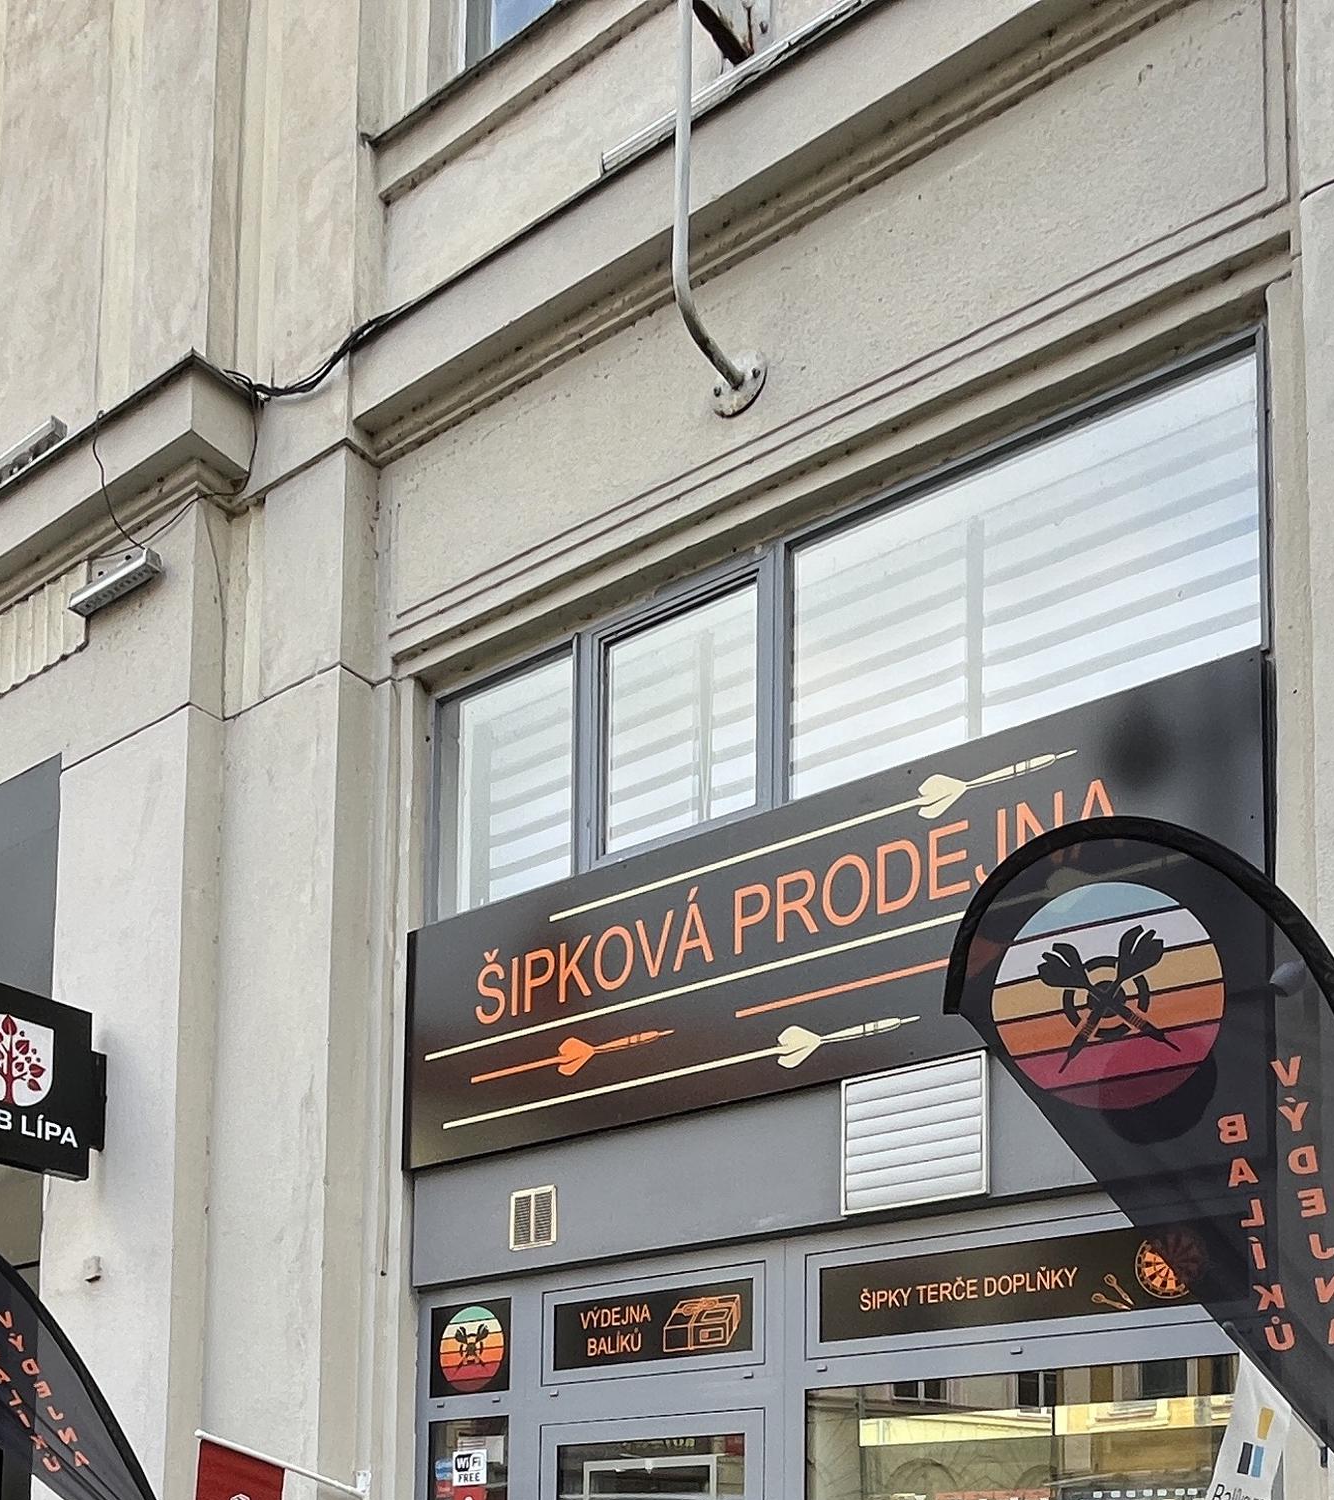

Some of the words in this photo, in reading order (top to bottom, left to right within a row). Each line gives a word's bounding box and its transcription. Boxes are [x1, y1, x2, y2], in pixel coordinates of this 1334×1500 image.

[474, 884, 716, 1026] ŠIPKOVÁ
[20, 1114, 79, 1149] LÍPA
[858, 1287, 912, 1312] ŠIPKY
[916, 1276, 979, 1305] TERČE
[983, 1265, 1079, 1298] DOPLŇKY
[580, 1303, 651, 1330] VÝDEJNA
[587, 1327, 642, 1357] BALÍKŮ
[458, 1472, 481, 1483] FREE
